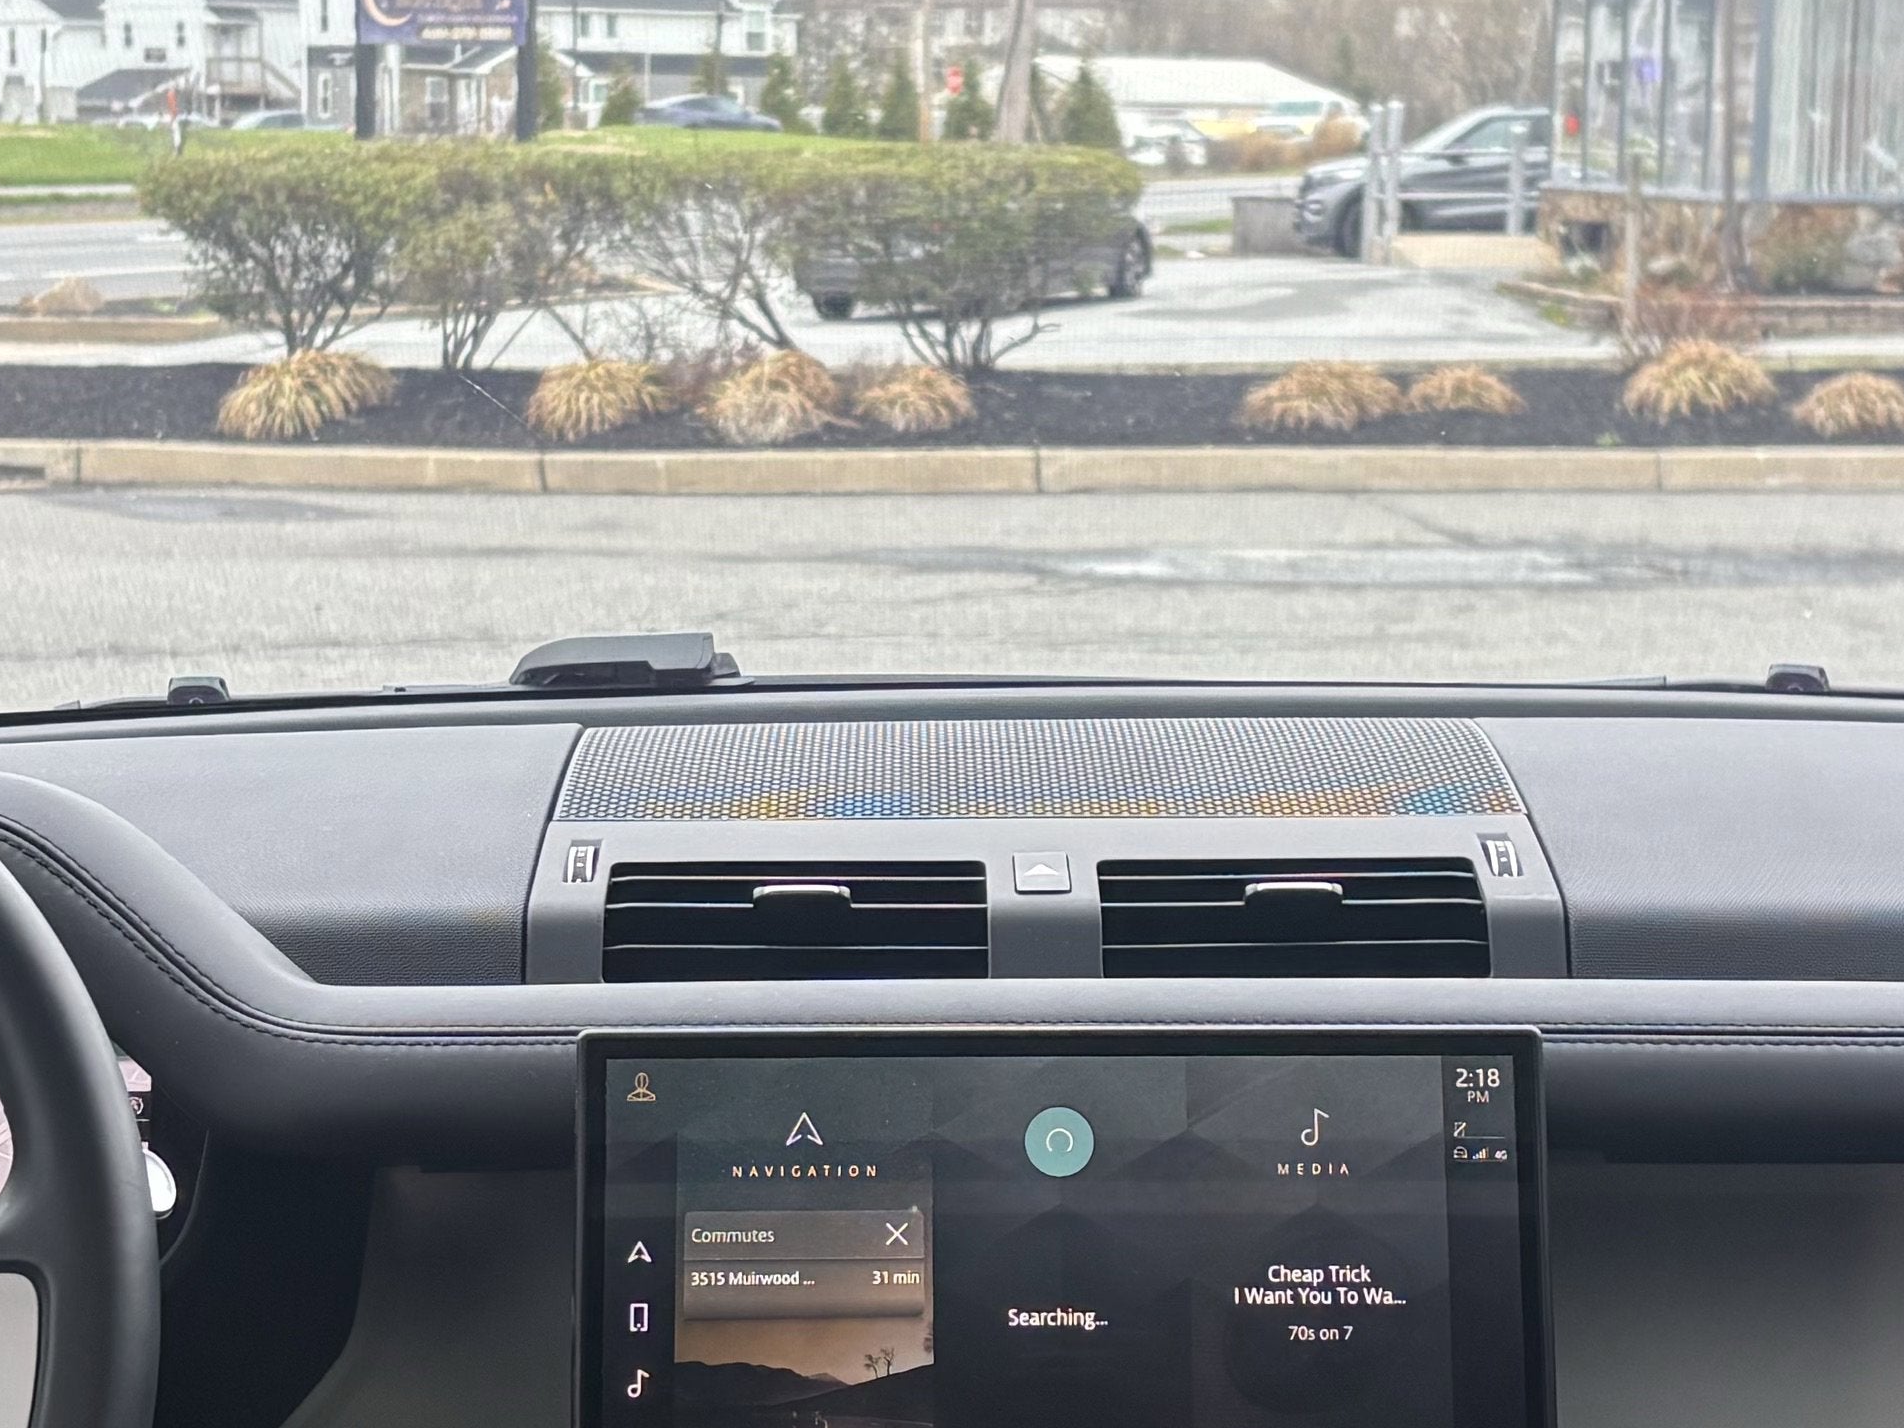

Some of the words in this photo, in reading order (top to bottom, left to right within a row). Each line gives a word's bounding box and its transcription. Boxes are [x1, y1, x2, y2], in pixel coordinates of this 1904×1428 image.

[1456, 1068, 1501, 1088] 2:18
[1467, 1090, 1490, 1103] PM
[732, 1165, 877, 1178] NAVIGATION
[1277, 1162, 1350, 1176] MEDIA
[691, 1228, 775, 1244] Commutes
[691, 1271, 726, 1286] 3515
[728, 1270, 800, 1286] Muirwood
[872, 1271, 889, 1285] 31
[893, 1270, 920, 1285] min
[1267, 1264, 1325, 1287] Cheap
[1328, 1264, 1372, 1283] Trick
[1234, 1287, 1240, 1305] I
[1244, 1287, 1295, 1305] Want
[1298, 1287, 1332, 1305] You
[1336, 1287, 1359, 1305] To
[1363, 1287, 1407, 1305] Wa...
[1008, 1307, 1109, 1331] Searching...
[1288, 1325, 1316, 1341] 70s
[1319, 1328, 1340, 1341] on
[1343, 1325, 1354, 1341] 7
